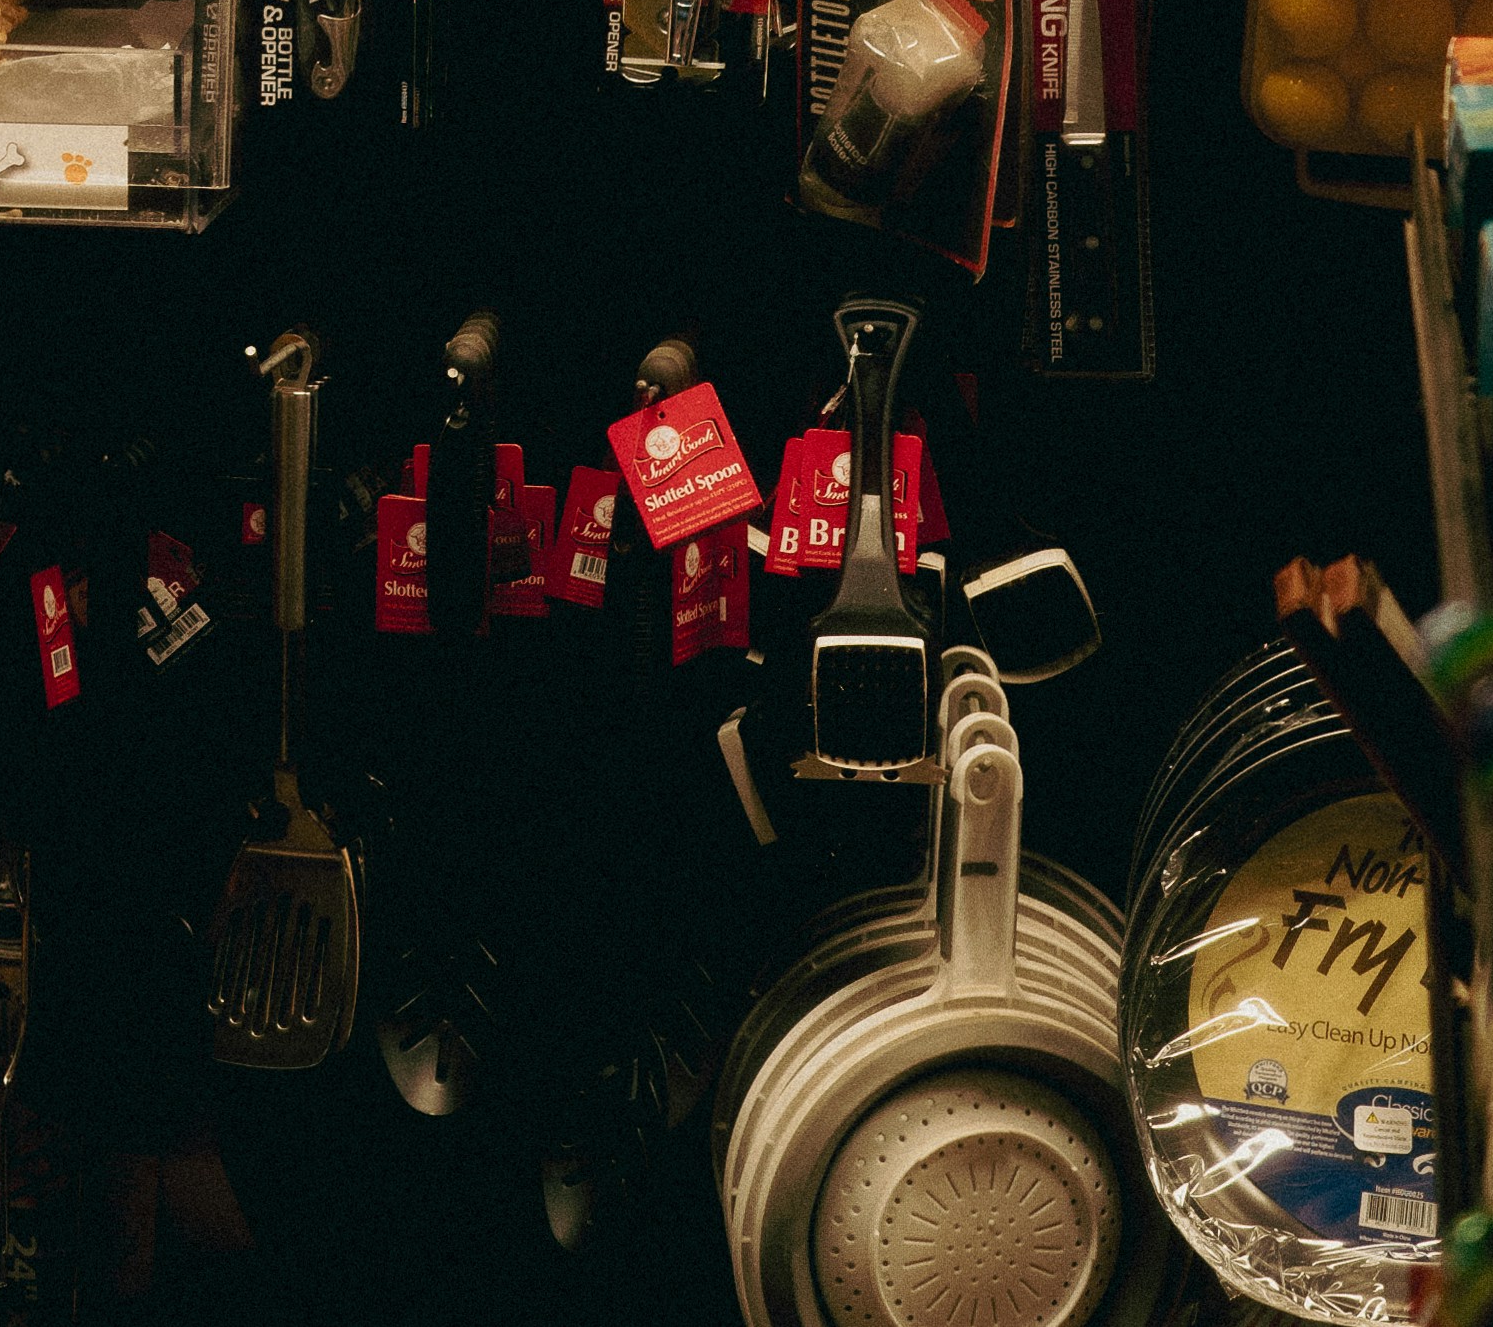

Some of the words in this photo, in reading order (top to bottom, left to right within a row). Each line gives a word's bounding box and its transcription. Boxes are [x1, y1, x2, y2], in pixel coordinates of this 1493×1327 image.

[259, 26, 277, 107] OPENER
[276, 25, 295, 103] BOTTLE
[1039, 42, 1061, 102] KNIFE
[643, 477, 693, 514] Slotted
[694, 460, 744, 491] Spoon
[1270, 887, 1417, 1018] Fry
[1265, 1017, 1306, 1041] Easy
[1310, 1020, 1362, 1046] Clean
[1366, 1023, 1396, 1050] Up
